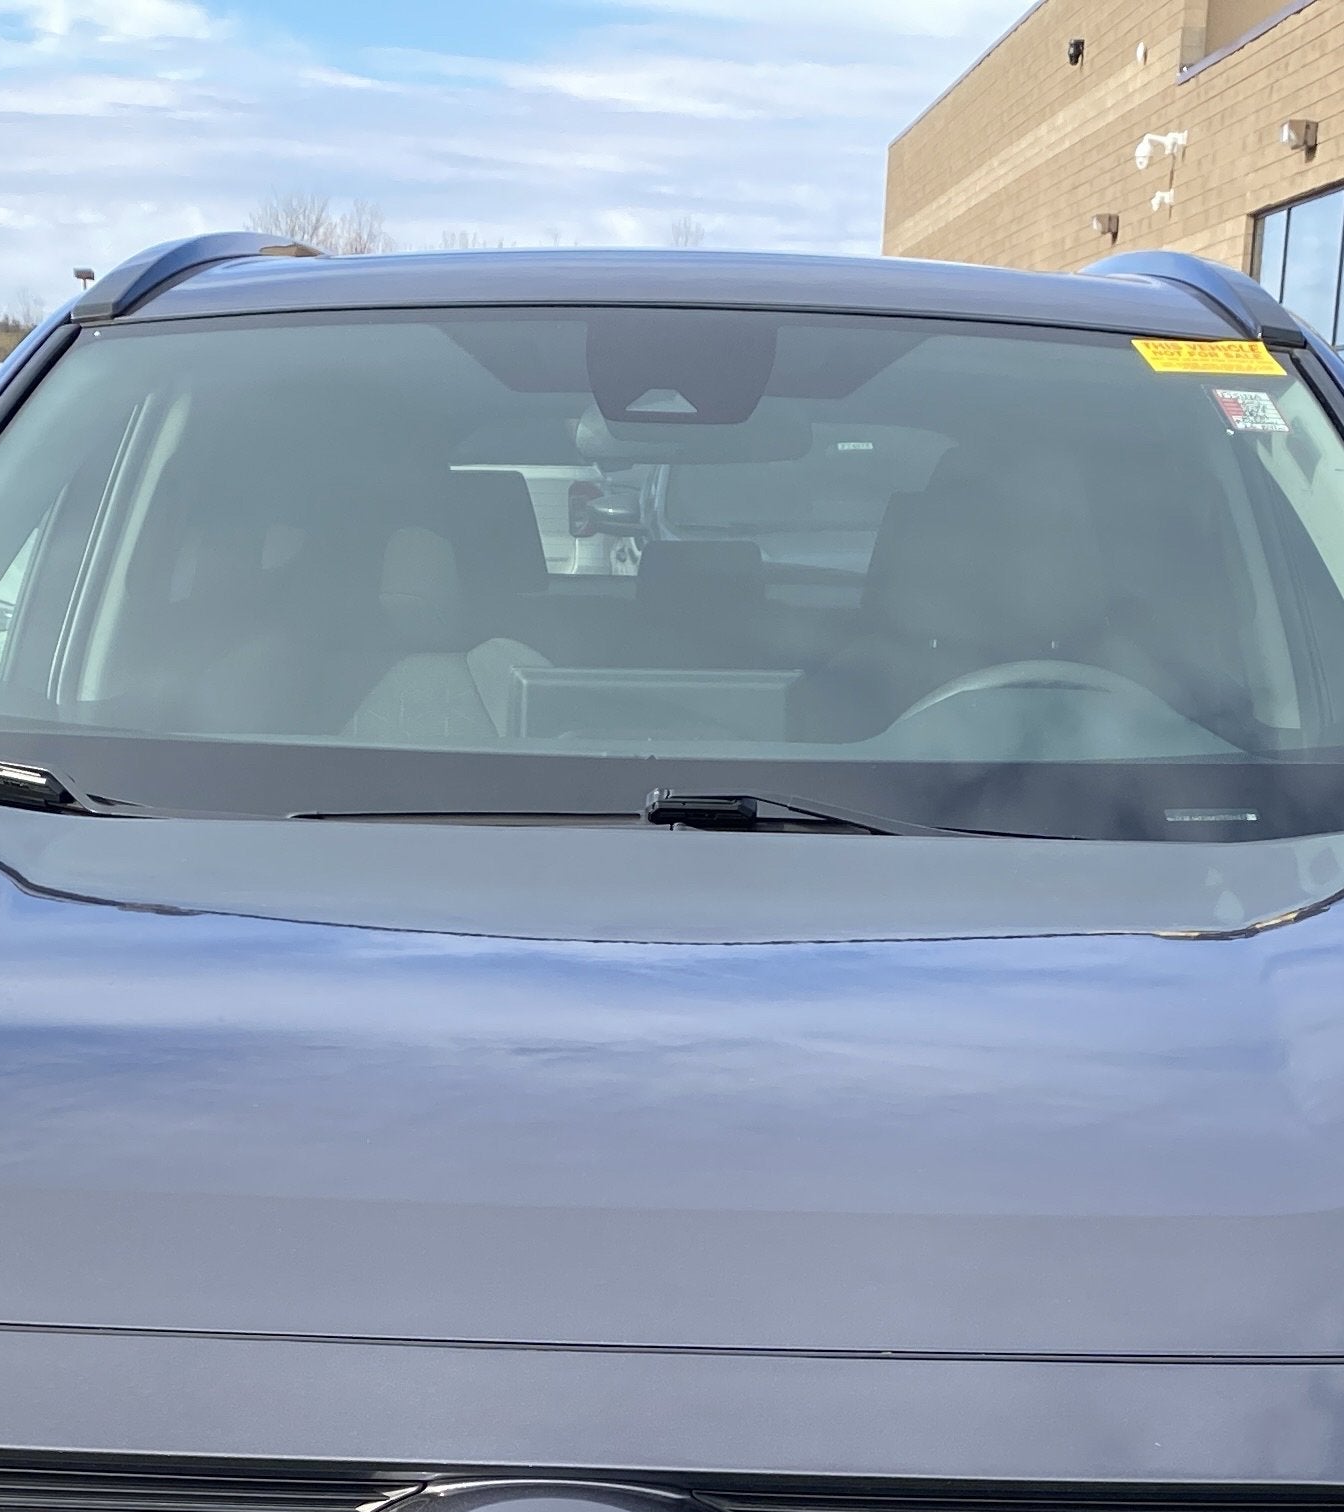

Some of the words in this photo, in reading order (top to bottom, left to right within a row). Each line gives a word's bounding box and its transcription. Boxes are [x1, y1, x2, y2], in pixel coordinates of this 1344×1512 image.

[1143, 342, 1183, 351] THIS
[1187, 343, 1260, 352] VEHICLE
[1223, 351, 1262, 359] SALE
